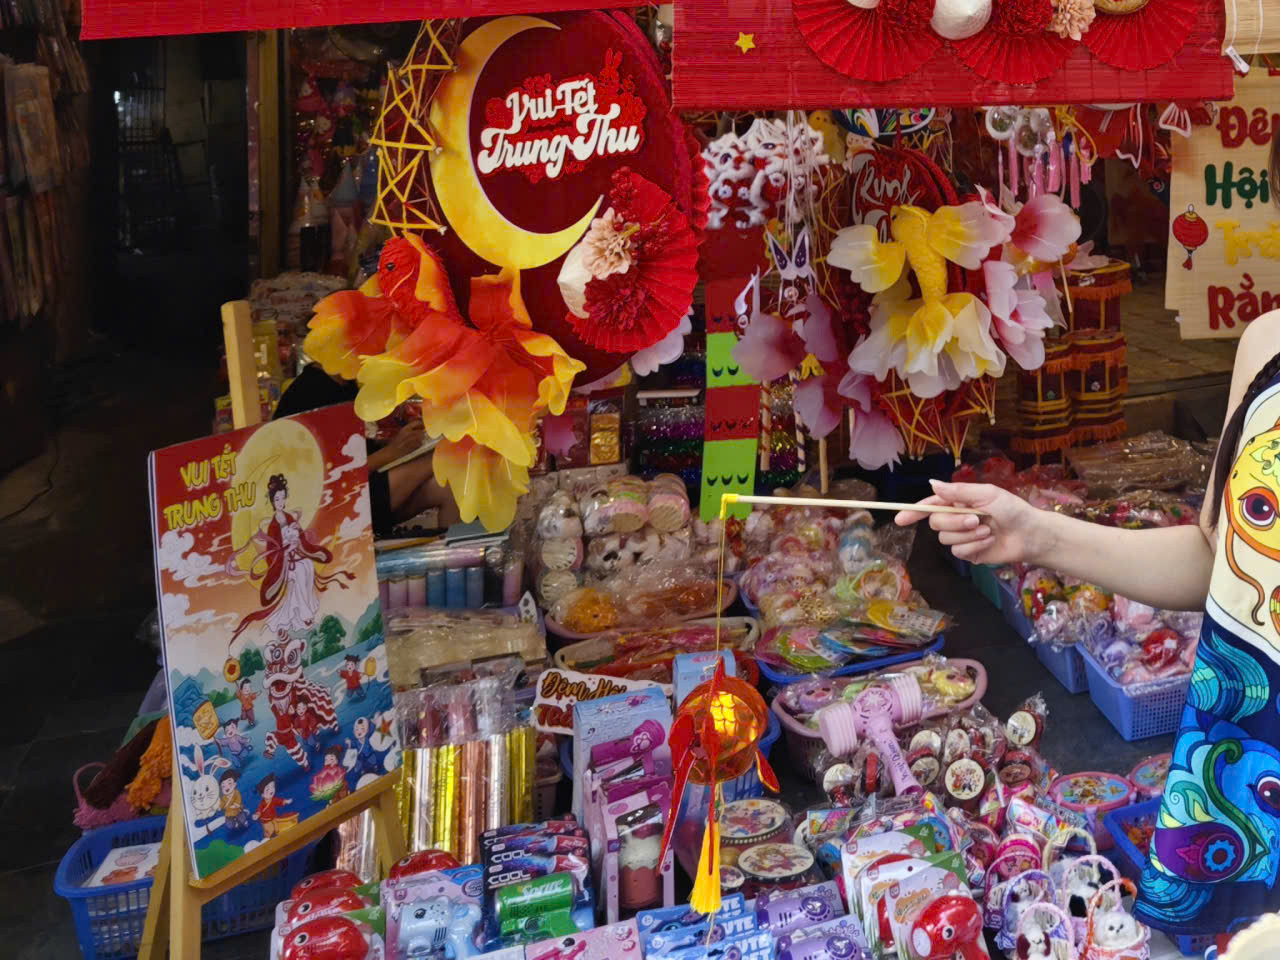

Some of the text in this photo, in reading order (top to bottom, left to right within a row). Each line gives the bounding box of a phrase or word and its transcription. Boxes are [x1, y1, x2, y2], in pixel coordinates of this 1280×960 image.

[555, 78, 598, 116] Tết
[477, 103, 640, 178] Trung Thu
[1204, 160, 1270, 209] Hội
[180, 443, 237, 490] VUI TẾT
[163, 481, 257, 531] TRUNG THU
[488, 870, 531, 885] COOL
[491, 849, 532, 863] COOL
